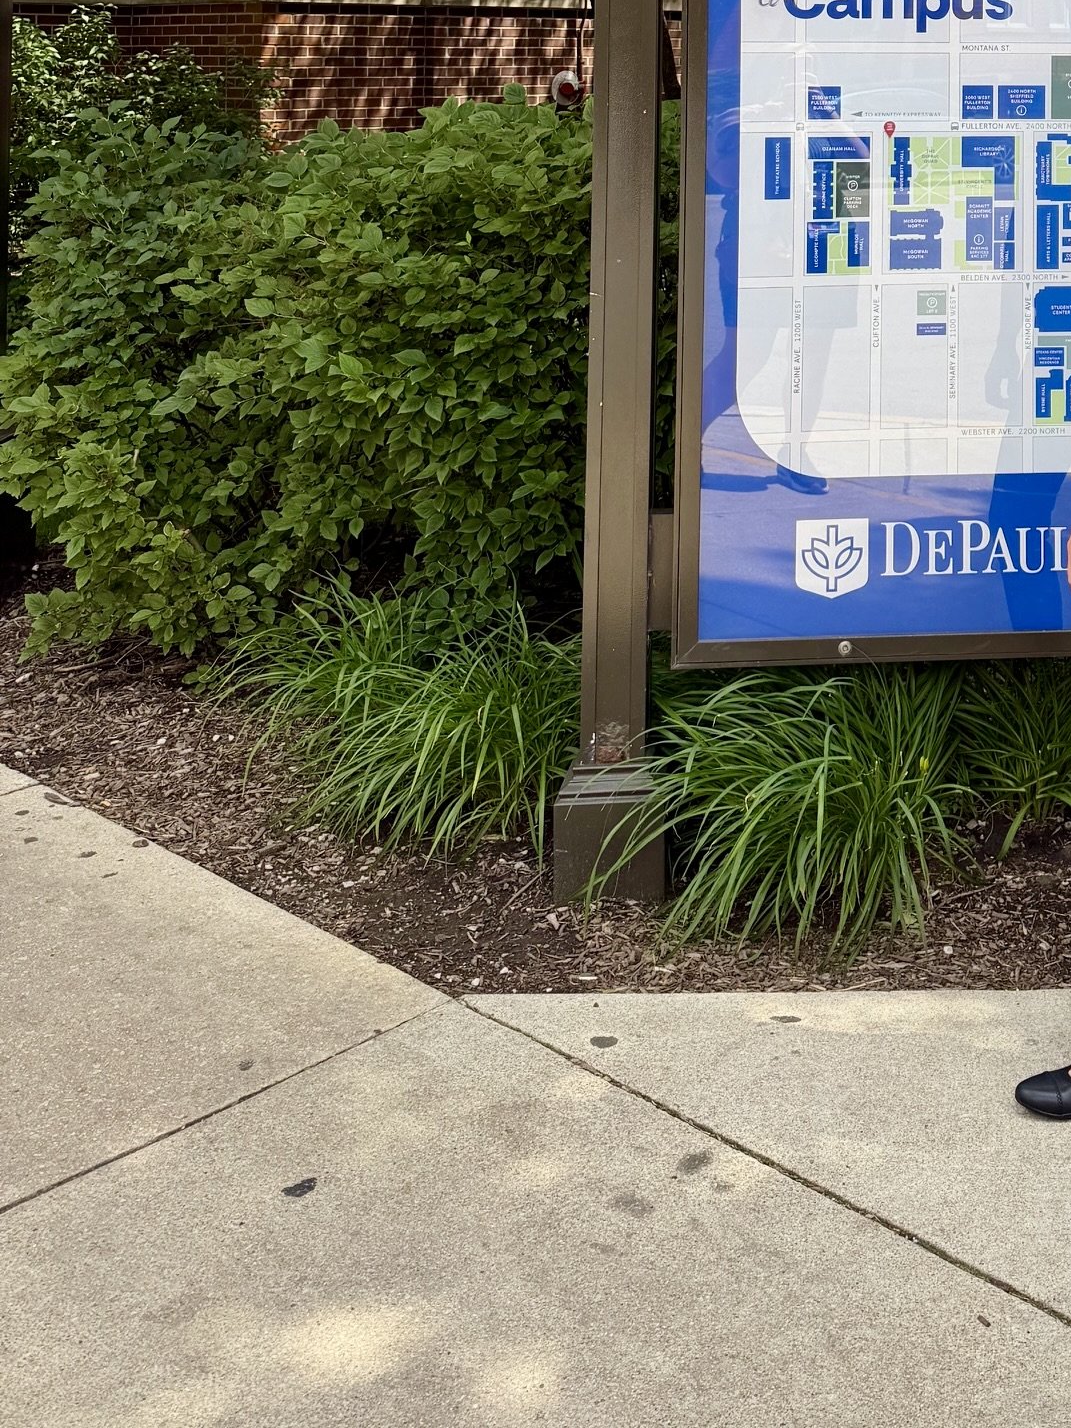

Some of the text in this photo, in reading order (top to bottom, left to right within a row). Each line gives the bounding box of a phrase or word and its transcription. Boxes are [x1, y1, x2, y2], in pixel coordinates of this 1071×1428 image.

[961, 122, 1004, 130] FULLERTON
[1006, 122, 1022, 130] AVE.
[1026, 122, 1045, 130] 2400
[1011, 273, 1031, 281] 2300
[794, 299, 802, 321] WEST
[872, 315, 880, 348] CLIFTON
[793, 346, 801, 364] AVE.
[793, 365, 801, 394] RACINE
[961, 427, 1066, 436] WEBSTER AVE. 2200 NORTH
